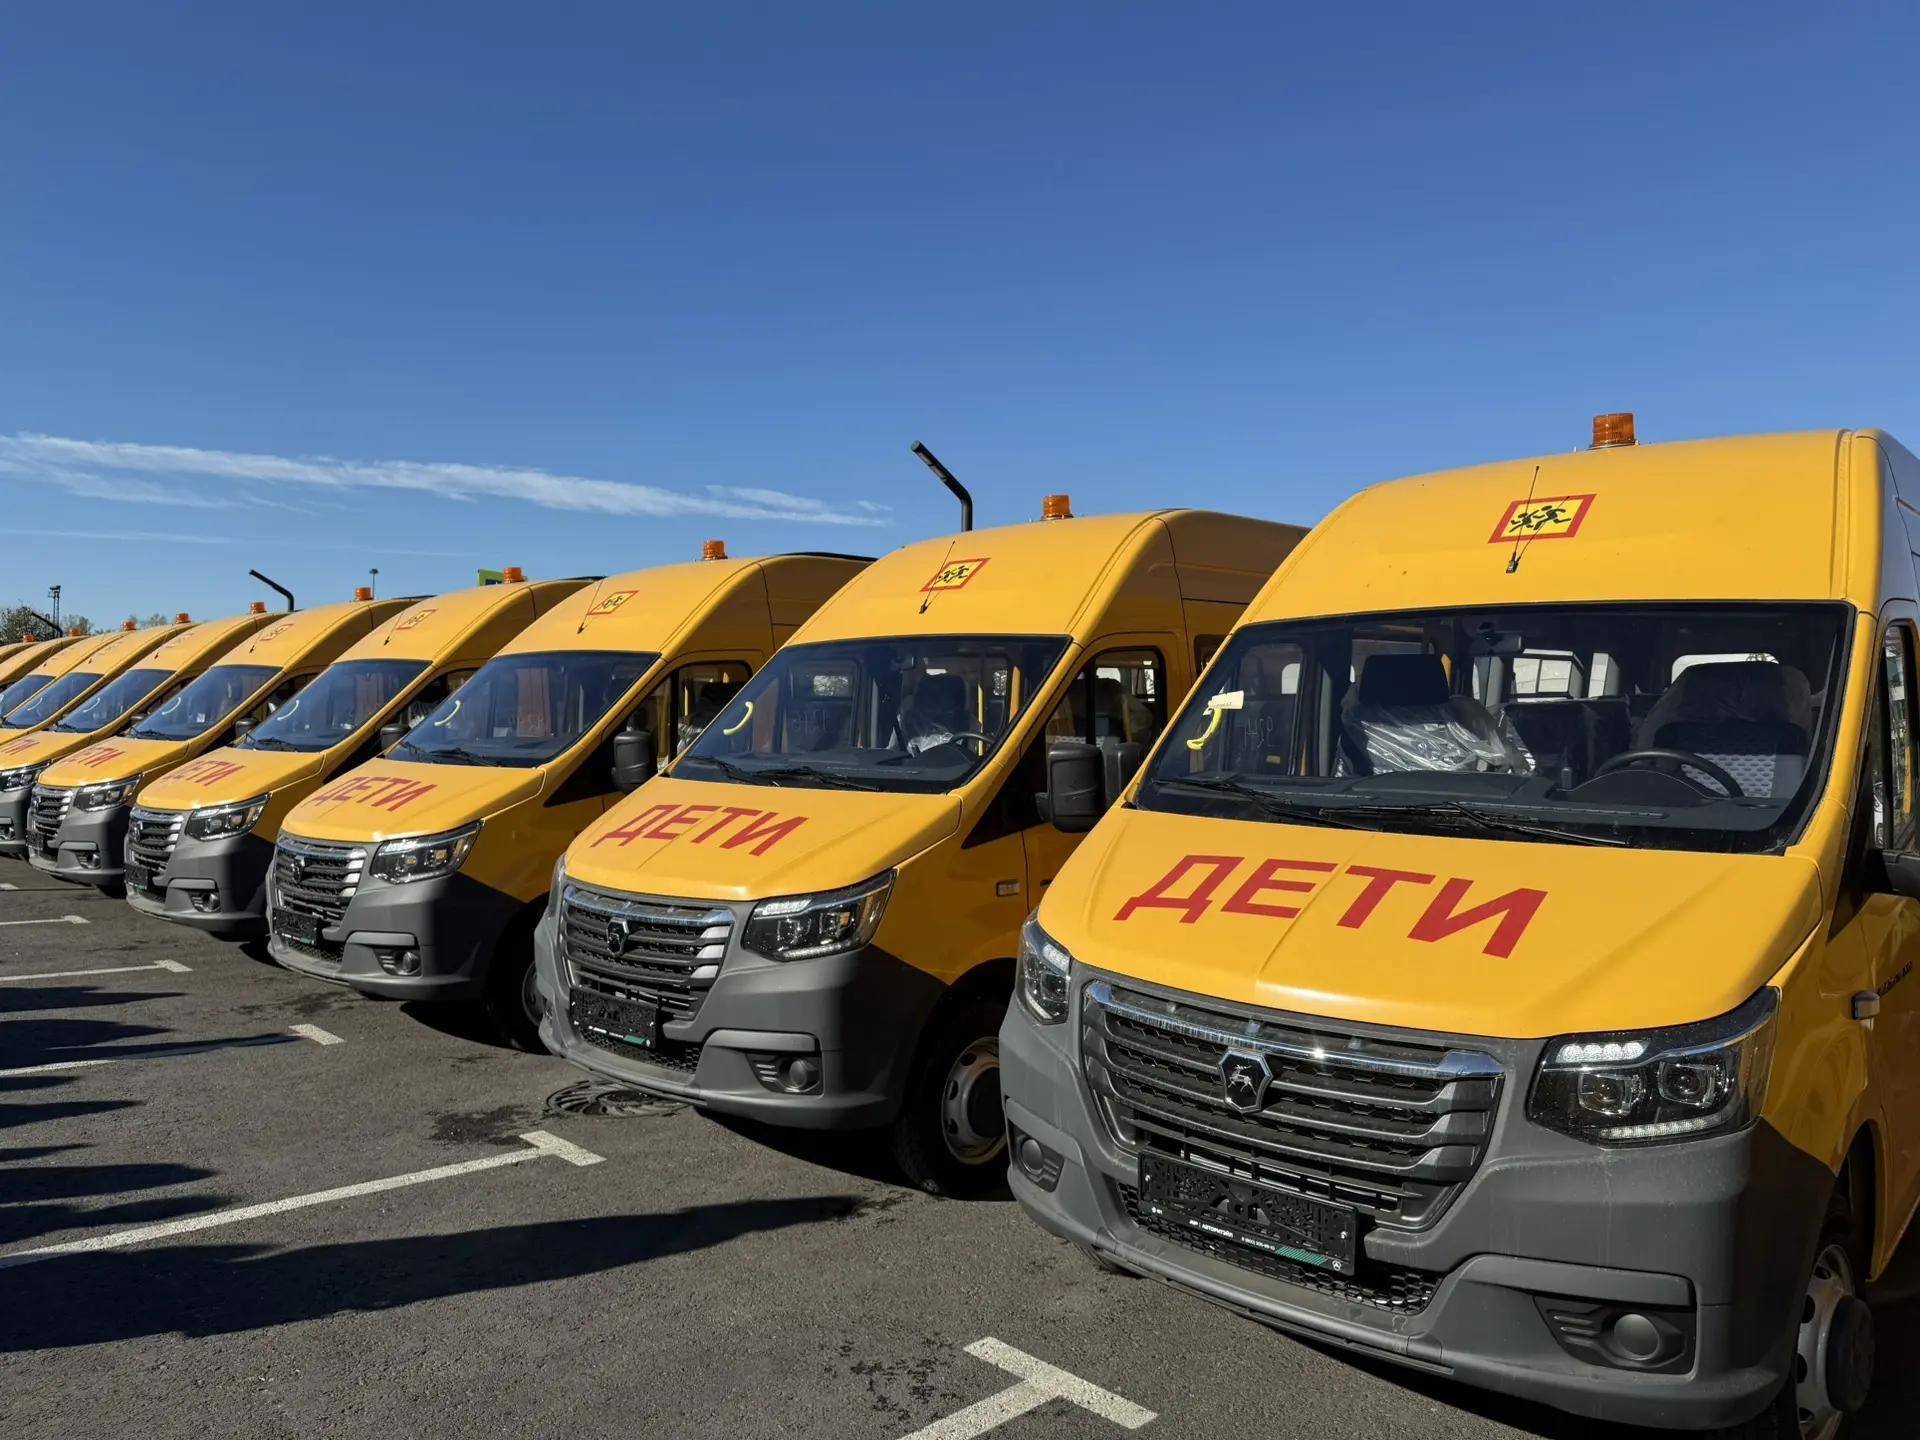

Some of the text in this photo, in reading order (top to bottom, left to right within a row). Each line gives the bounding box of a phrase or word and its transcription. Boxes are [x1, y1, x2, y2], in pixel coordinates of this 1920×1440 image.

[301, 777, 438, 812] ДЕТИ
[589, 804, 809, 856] ДЕТИ
[1112, 854, 1549, 959] ДЕТИ
